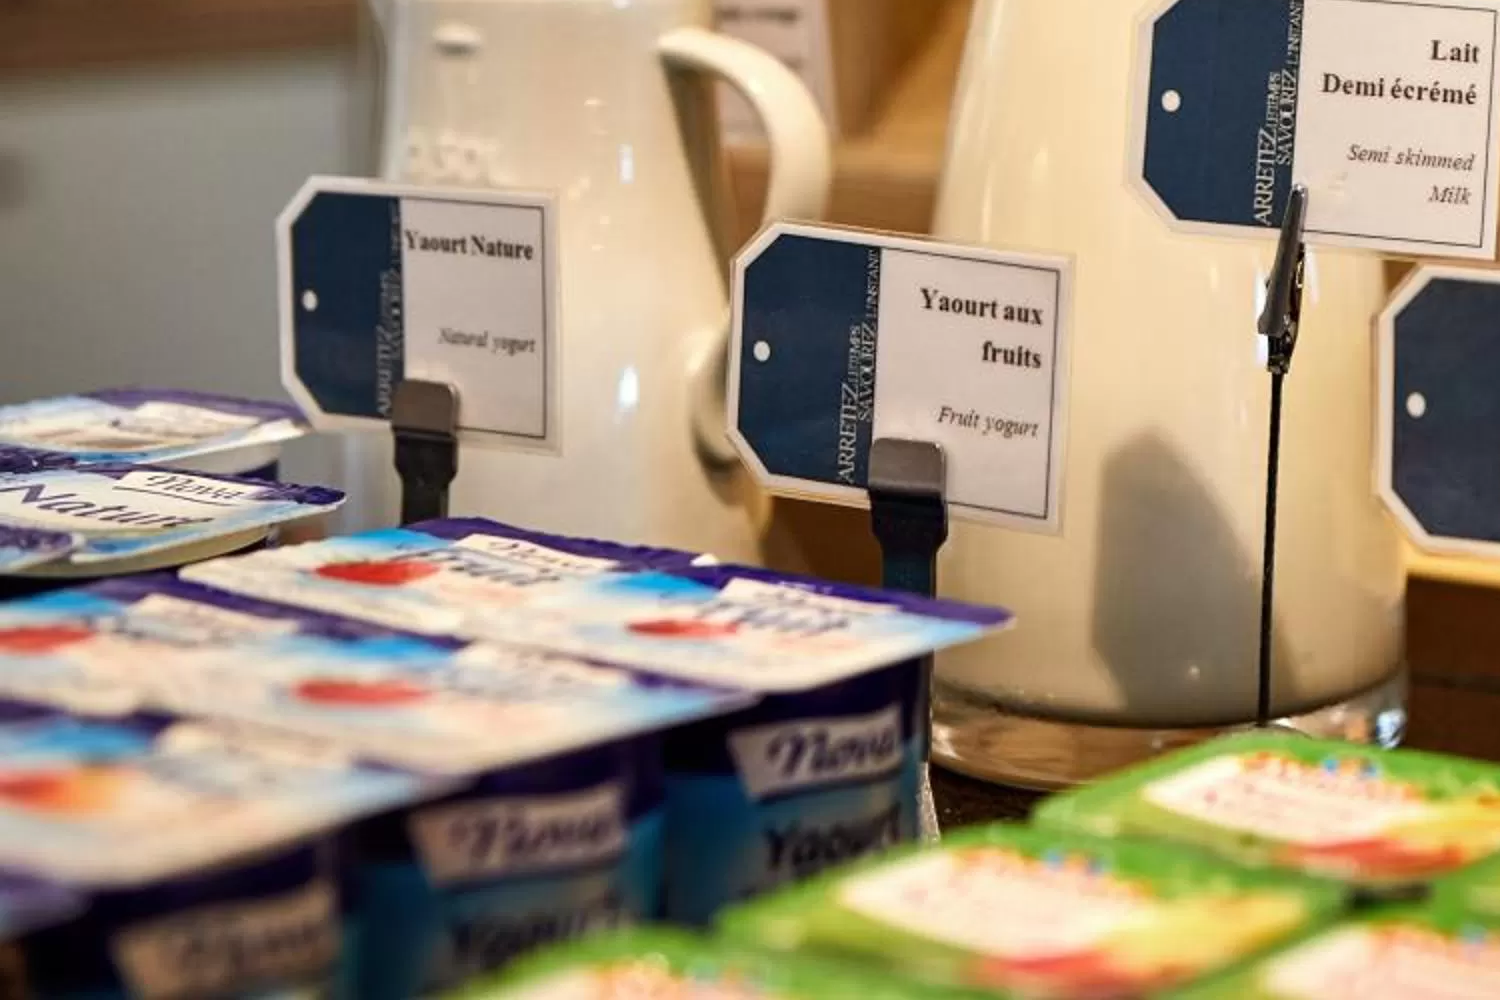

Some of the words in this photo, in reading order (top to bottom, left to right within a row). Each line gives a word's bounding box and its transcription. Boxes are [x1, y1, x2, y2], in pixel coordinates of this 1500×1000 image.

[1430, 39, 1480, 64] Lait
[1322, 73, 1384, 98] Demi
[1391, 77, 1478, 105] écrémé
[1276, 69, 1297, 166] SAVOUREZ
[1347, 143, 1391, 162] Semi
[1394, 146, 1475, 172] skimmed
[1427, 184, 1473, 206] Milk
[405, 229, 467, 254] Yaourt
[470, 234, 534, 260] Nature
[920, 287, 997, 317] Yaourt
[1003, 304, 1043, 326] aux
[438, 327, 489, 348] Natural
[492, 337, 536, 357] yogurt
[981, 340, 1042, 369] fruits
[937, 405, 980, 428] Fruit
[981, 413, 1039, 438] yogurt
